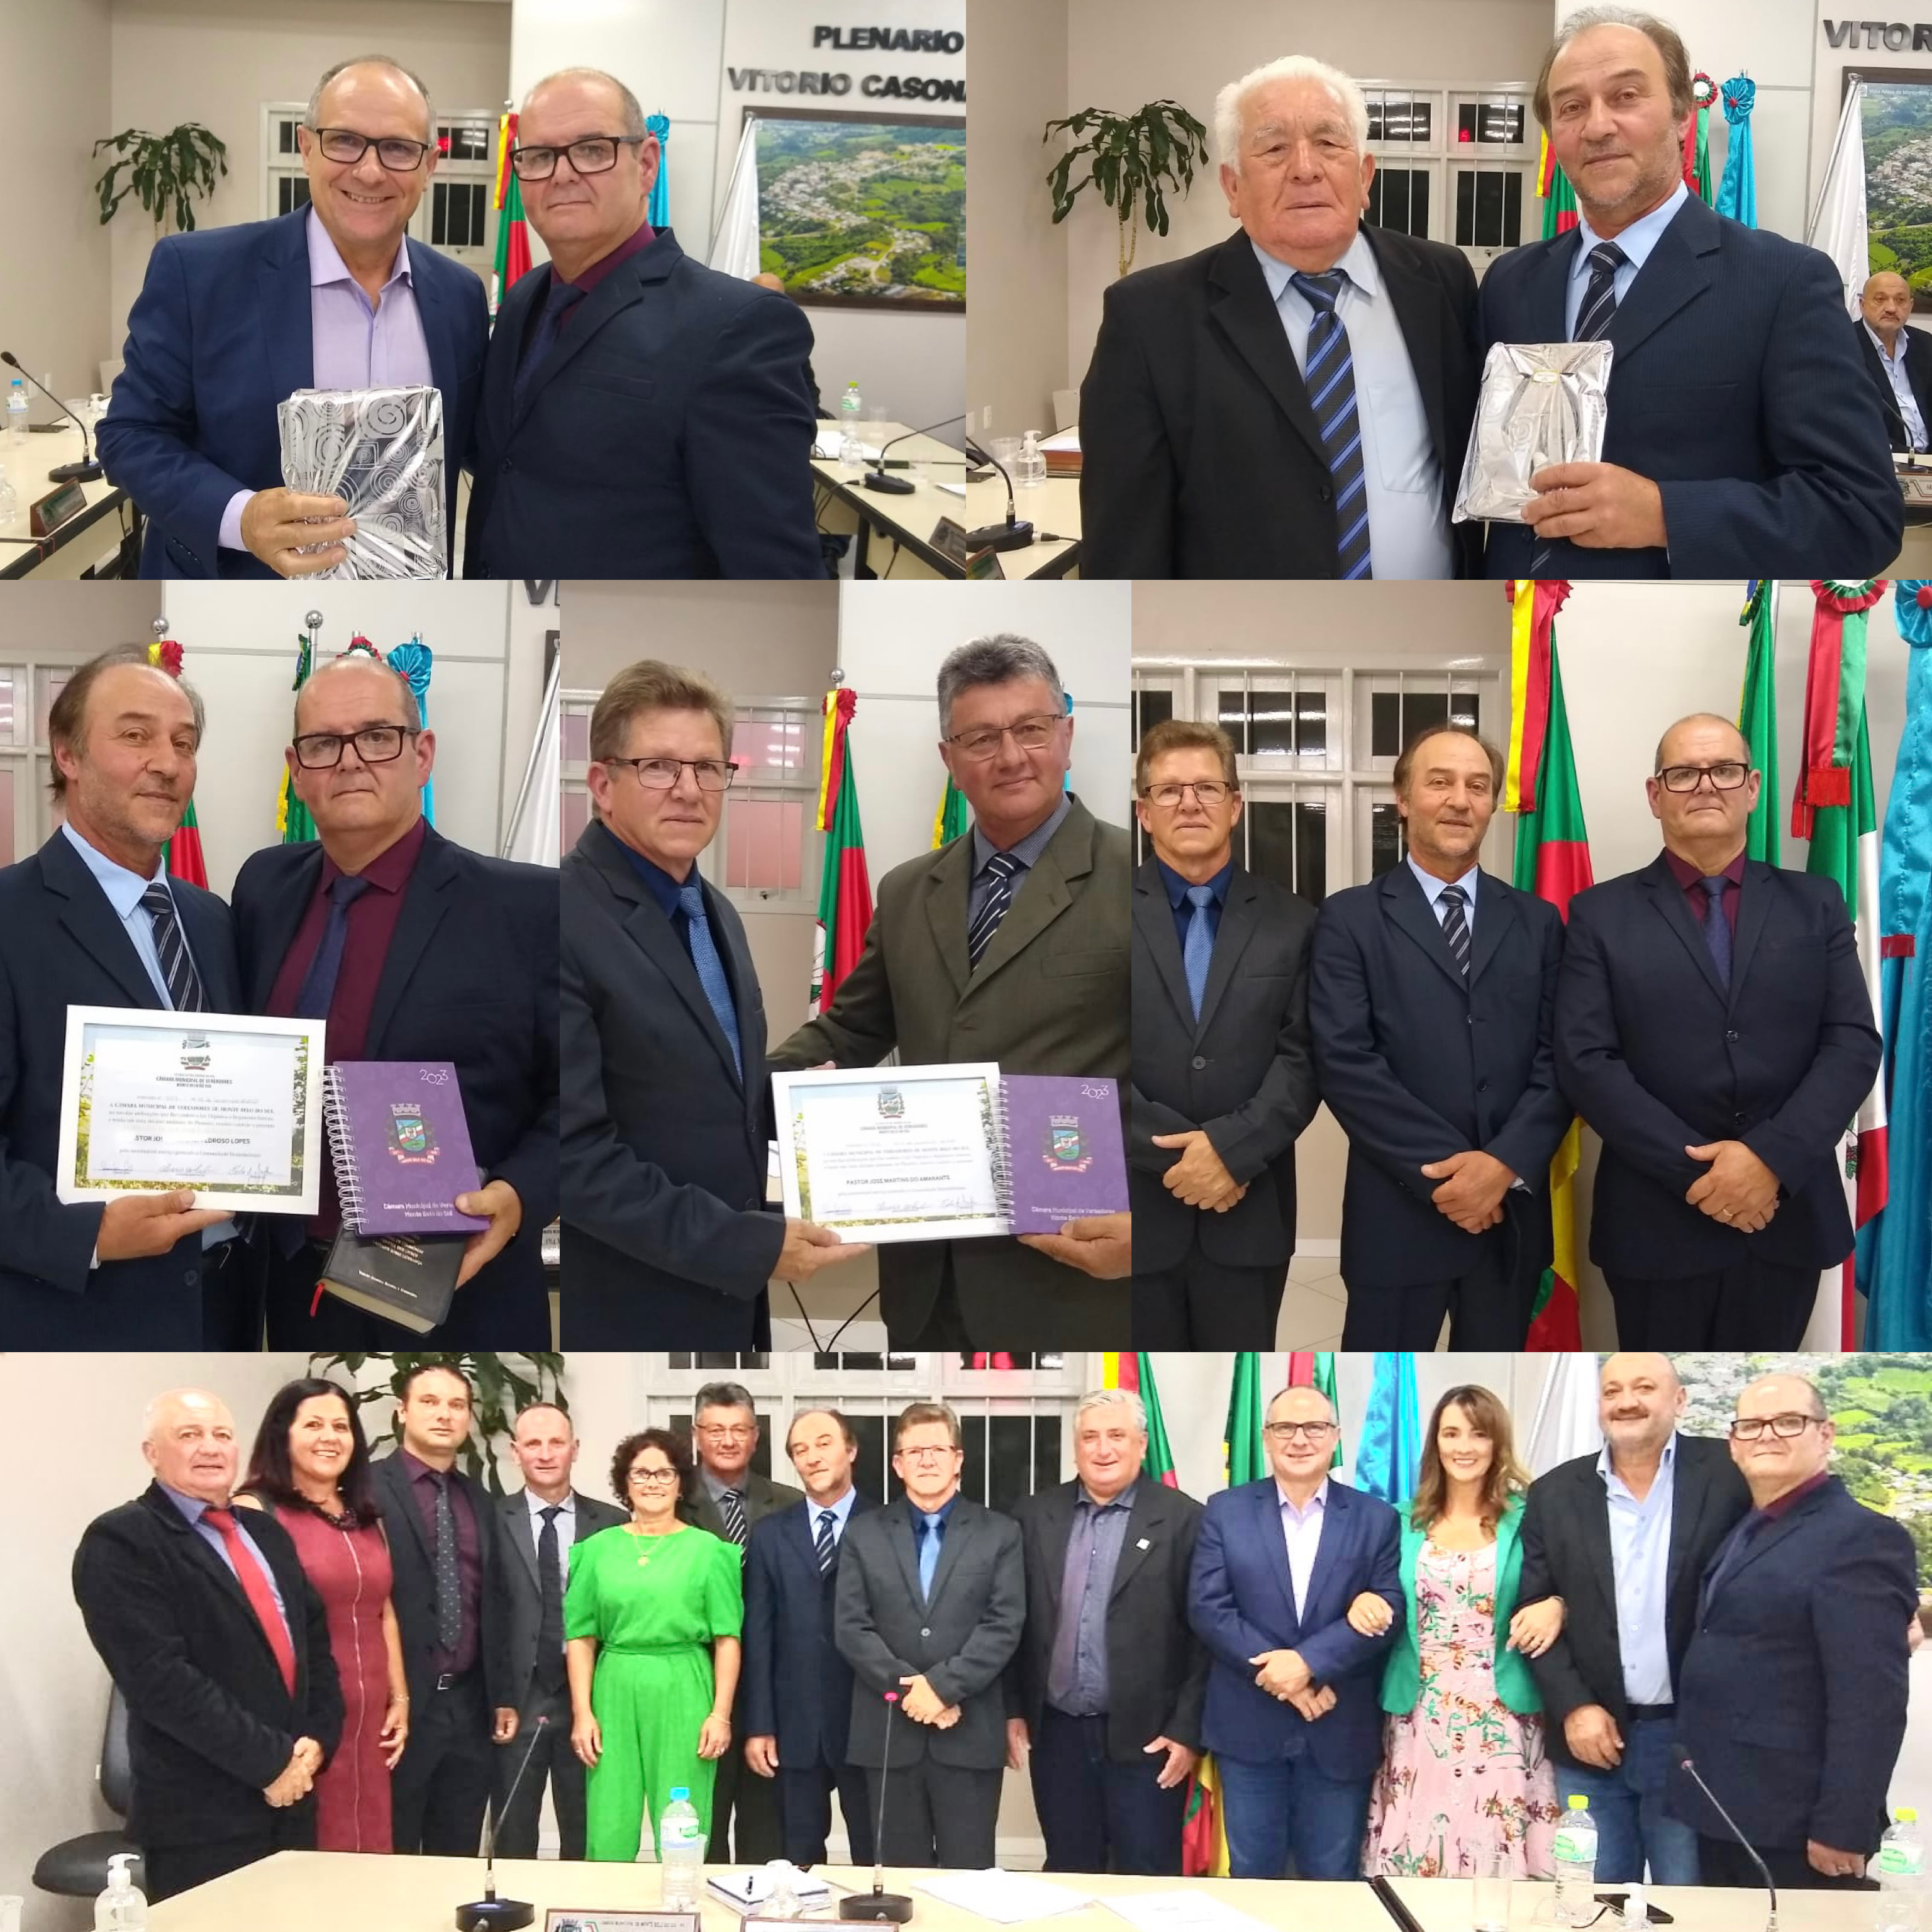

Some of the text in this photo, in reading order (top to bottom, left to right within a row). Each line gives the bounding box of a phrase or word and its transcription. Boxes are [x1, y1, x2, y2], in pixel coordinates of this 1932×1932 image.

[813, 25, 964, 54] PLENARIO
[728, 67, 966, 103] VITORIO CASON
[419, 1069, 448, 1085] 2023
[1080, 1084, 1109, 1099] 2023
